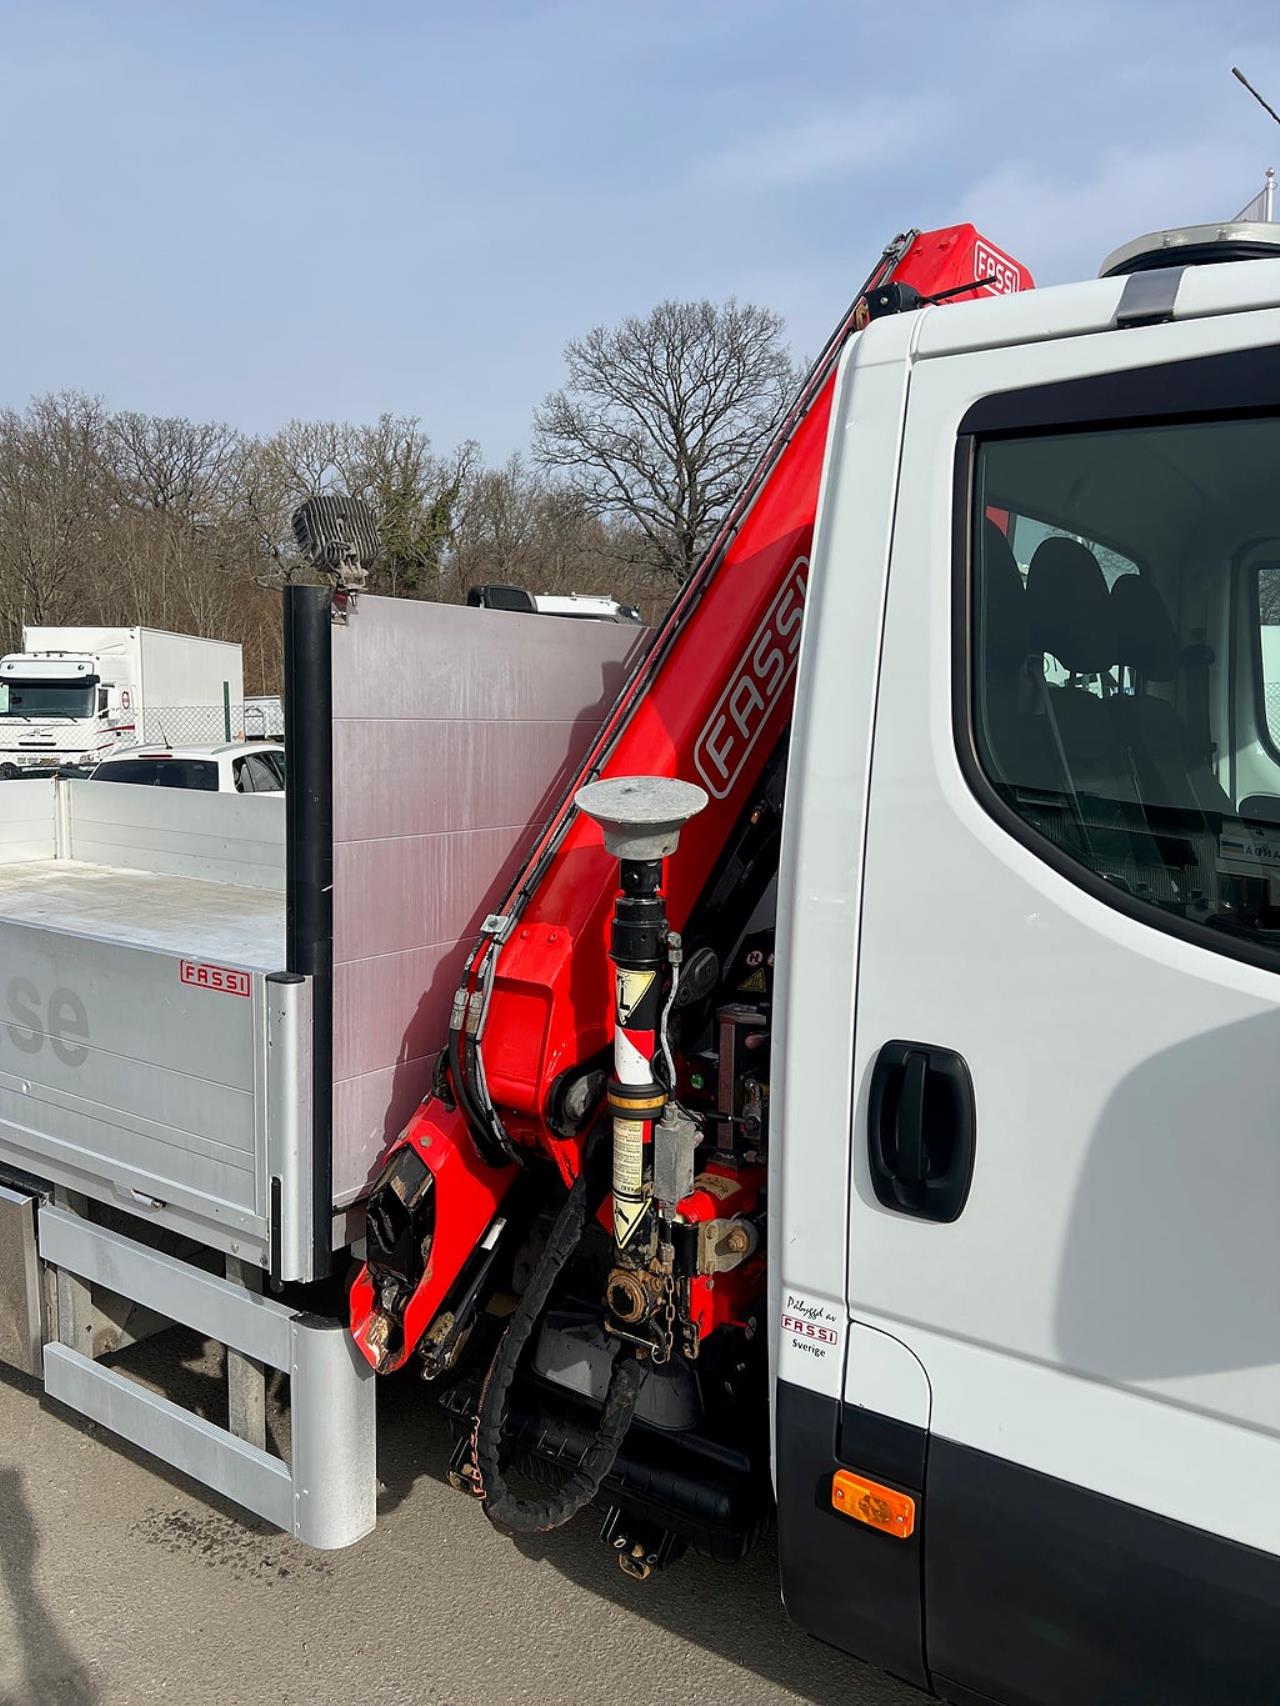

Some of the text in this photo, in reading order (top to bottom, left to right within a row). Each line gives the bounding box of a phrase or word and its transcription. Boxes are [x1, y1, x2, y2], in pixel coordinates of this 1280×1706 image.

[979, 250, 1017, 294] FASSI
[705, 574, 808, 779] FASSI
[185, 965, 245, 992] FASSI
[784, 1317, 834, 1342] FASSI
[825, 1314, 837, 1322] av
[792, 1338, 826, 1358] Sverige
